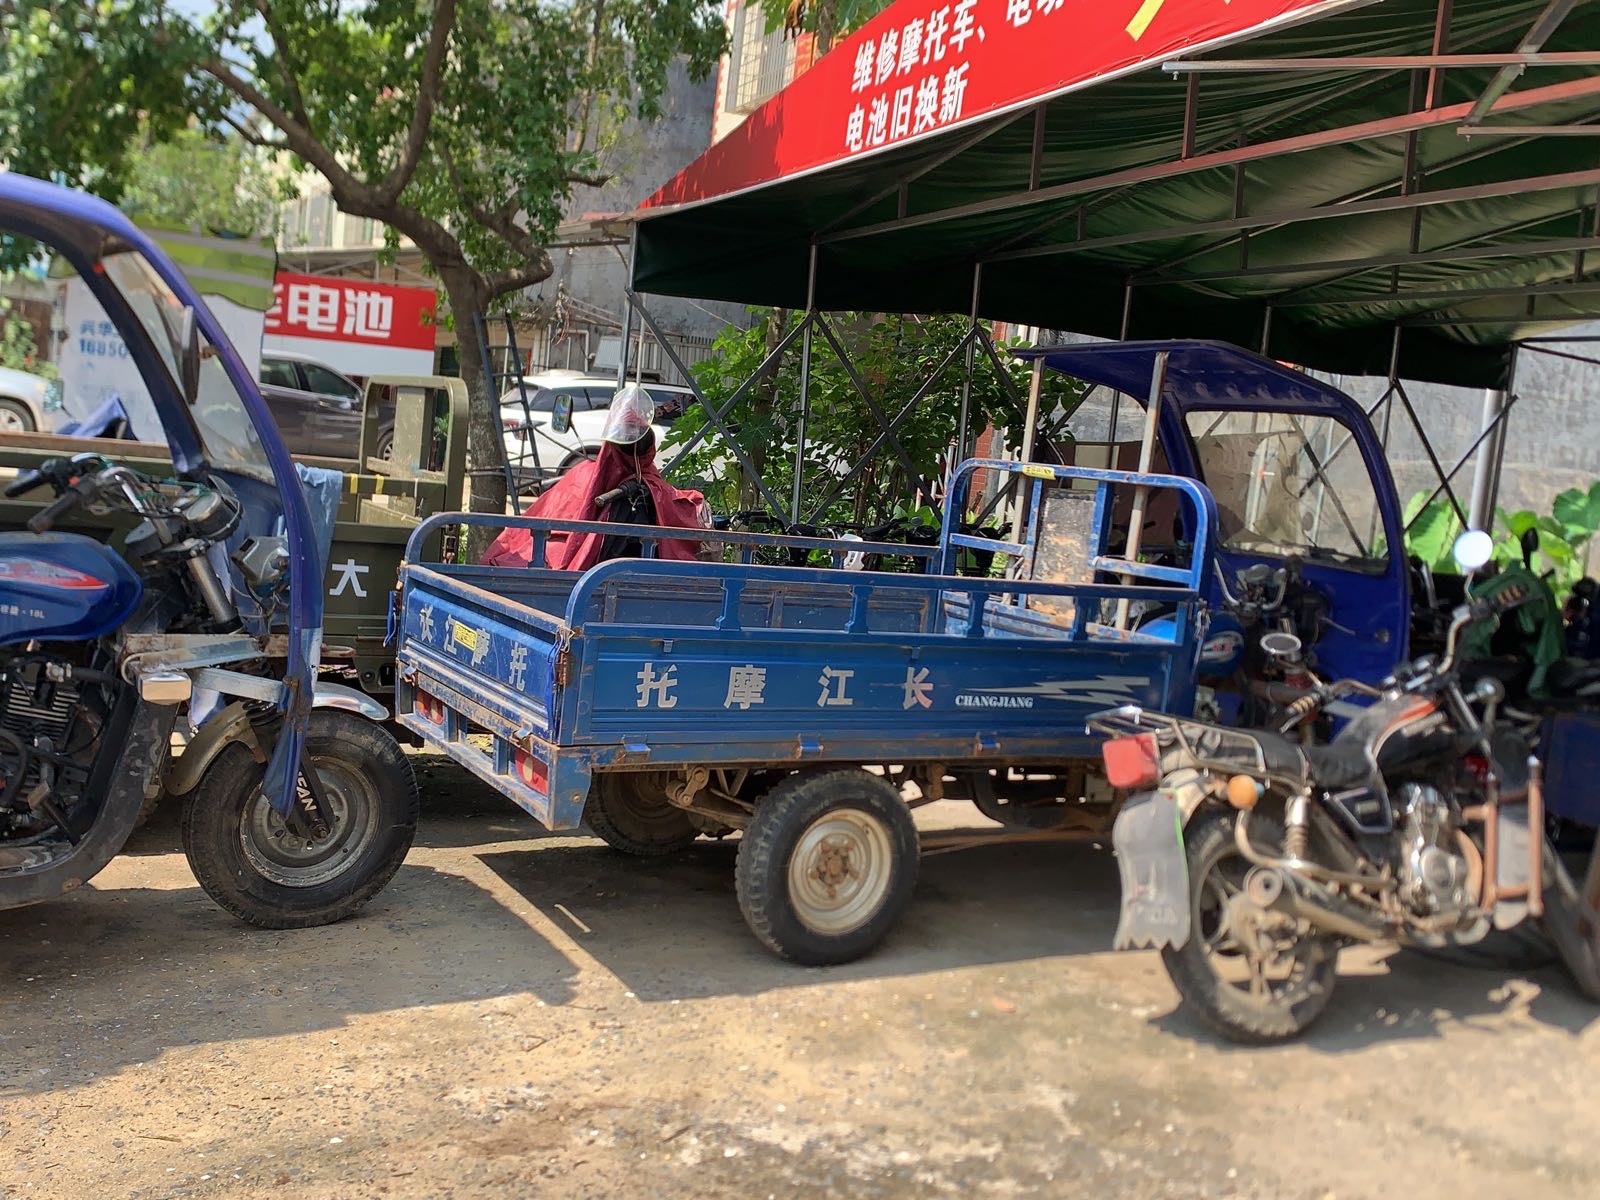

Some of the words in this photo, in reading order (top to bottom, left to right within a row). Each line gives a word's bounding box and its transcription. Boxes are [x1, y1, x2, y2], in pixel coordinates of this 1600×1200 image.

[844, 62, 970, 153] 电池旧换新
[329, 558, 369, 597] 大
[954, 694, 1034, 709] CHANGJIANG
